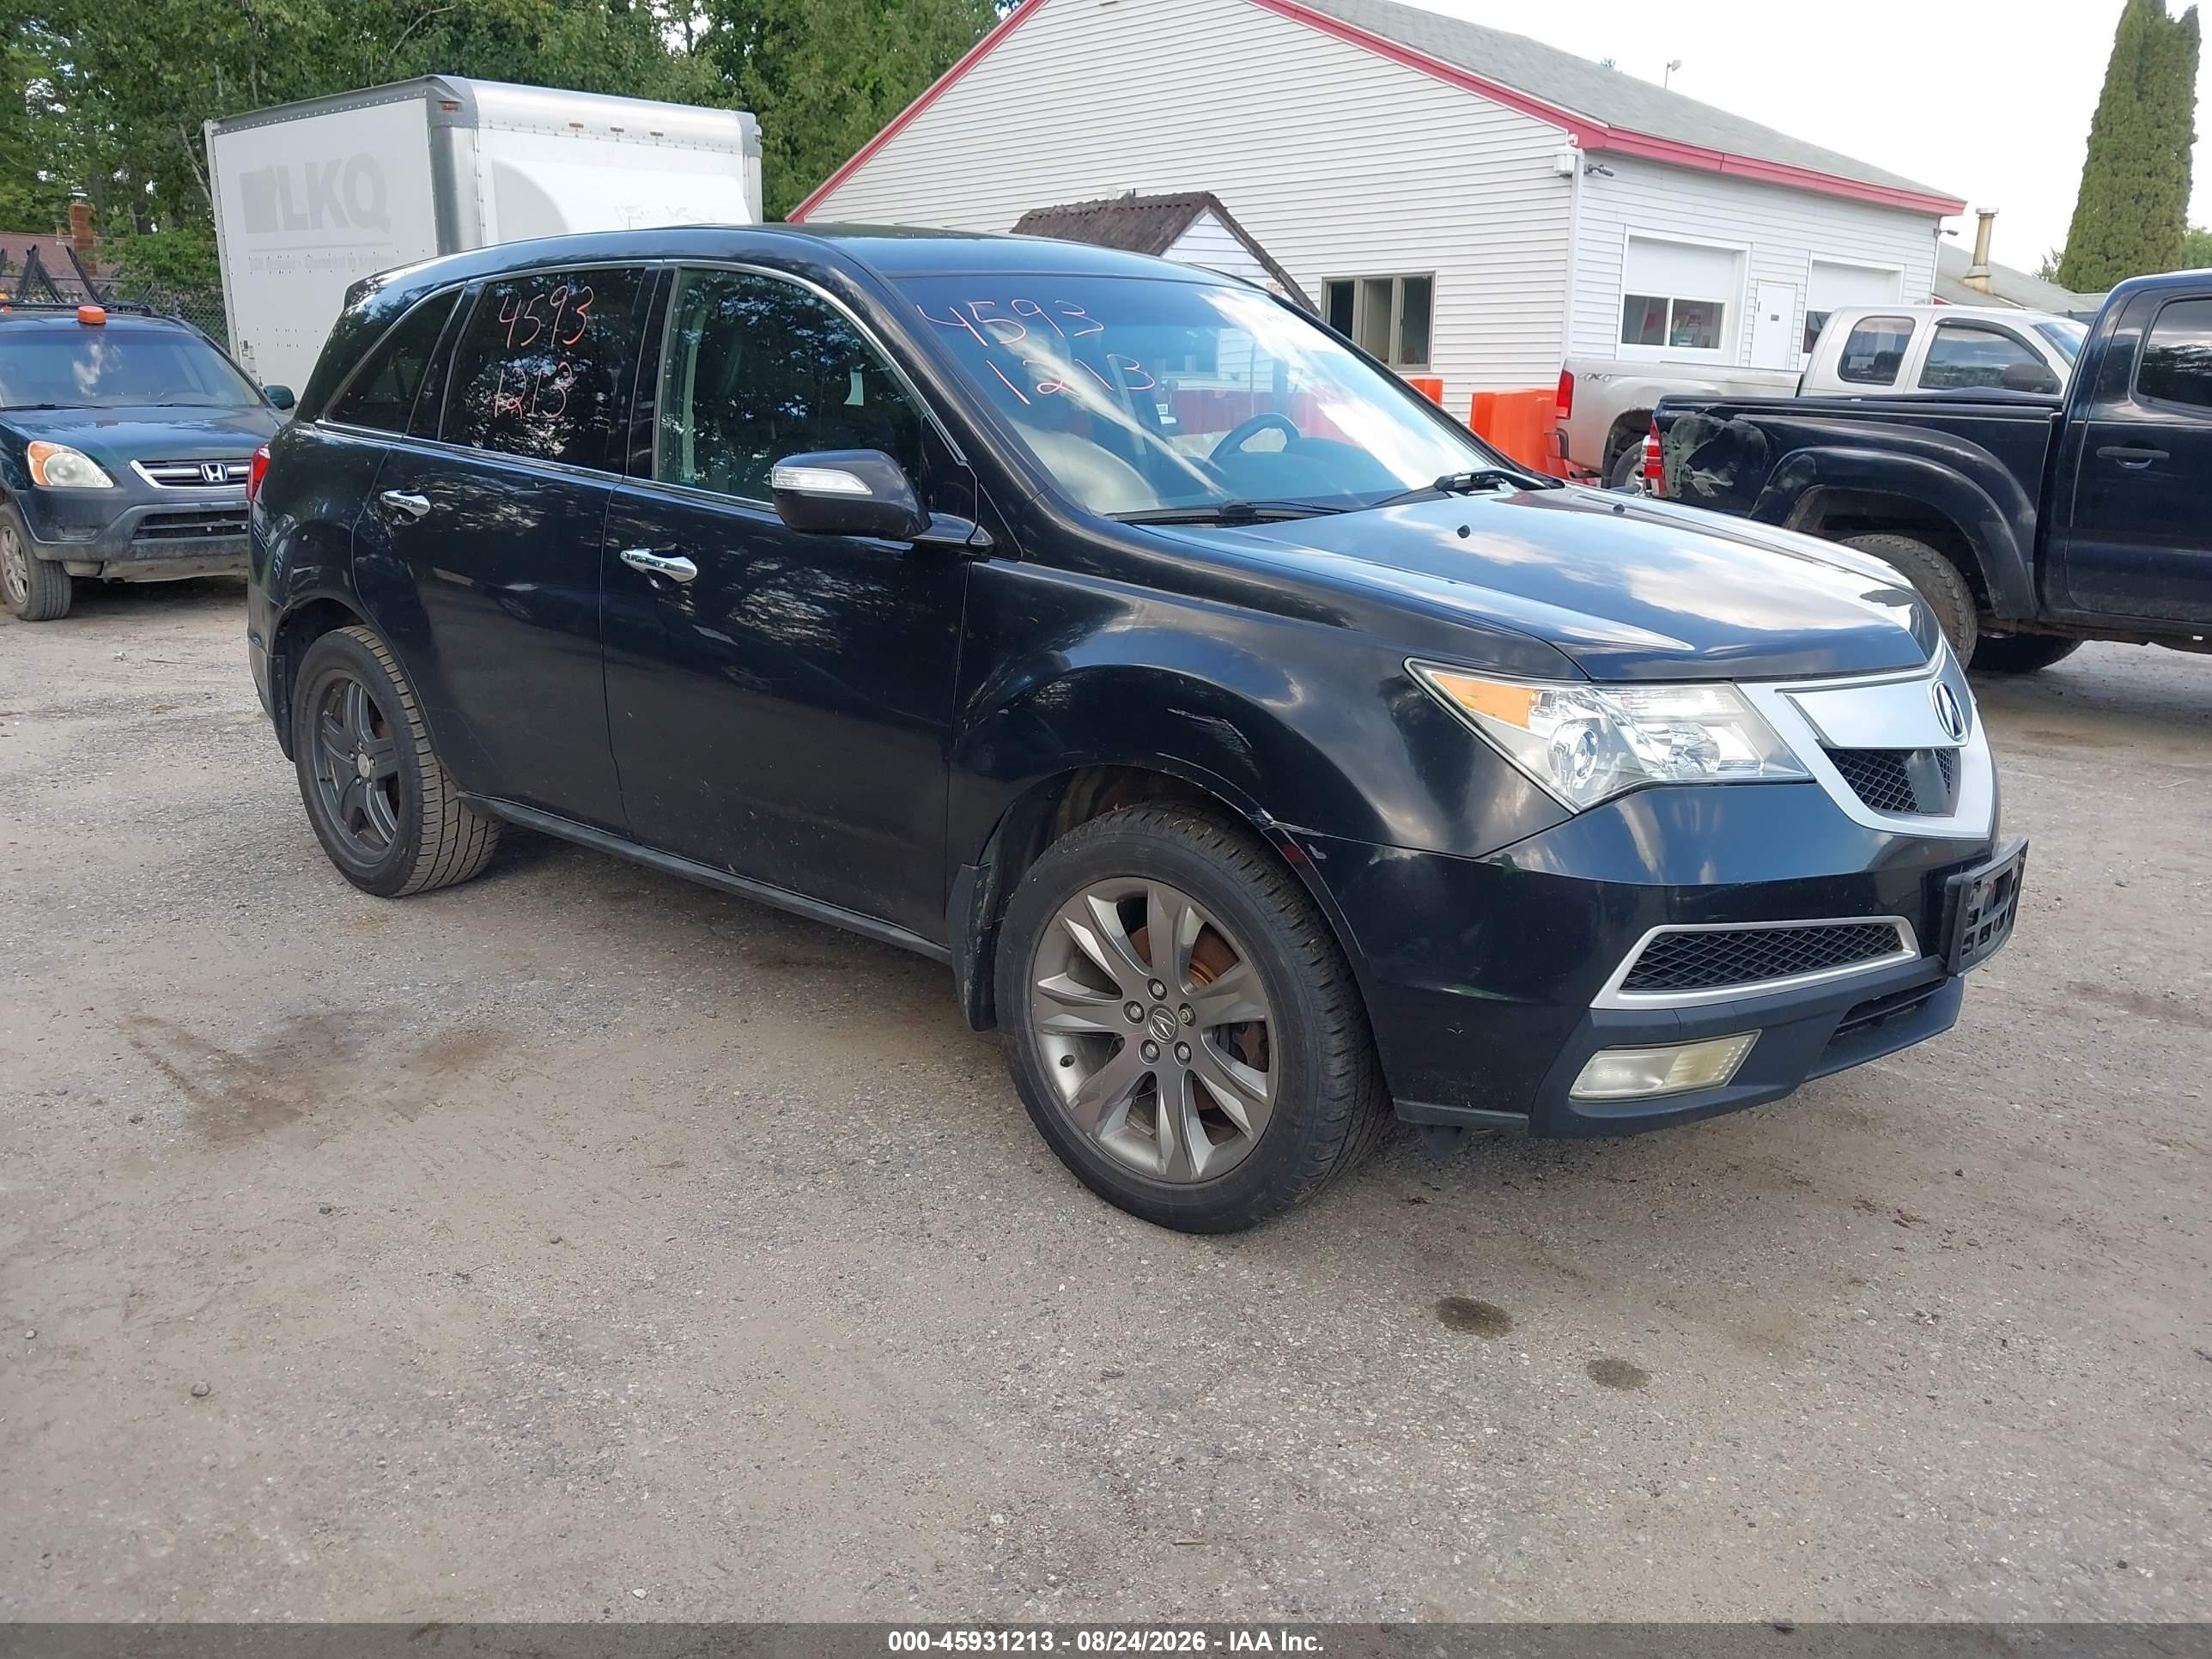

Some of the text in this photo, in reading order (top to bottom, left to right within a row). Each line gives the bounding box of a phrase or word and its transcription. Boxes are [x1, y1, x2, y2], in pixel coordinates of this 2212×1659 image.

[276, 152, 392, 234] LKQ
[499, 285, 594, 350] 4593
[915, 299, 1105, 347] 4593
[494, 362, 573, 420] 1213
[985, 354, 1156, 406] 1213
